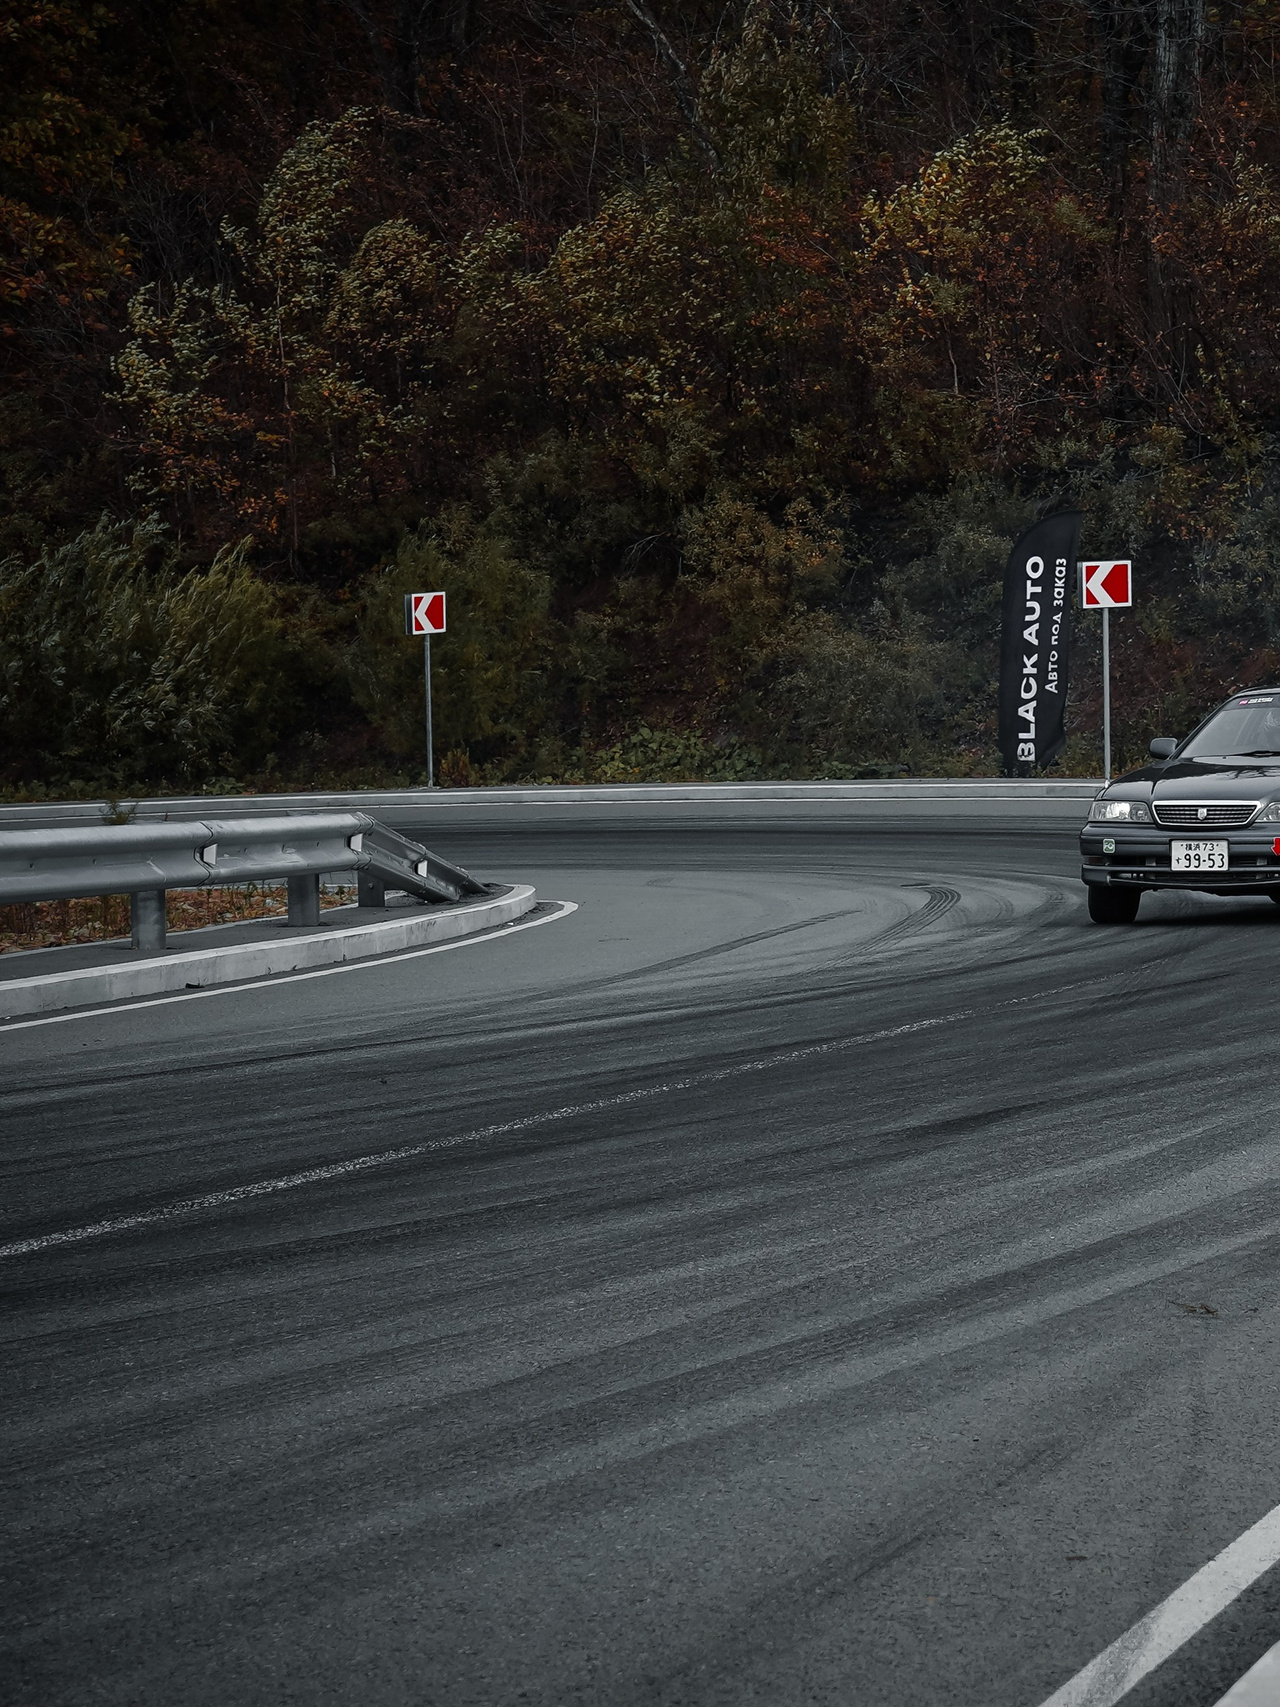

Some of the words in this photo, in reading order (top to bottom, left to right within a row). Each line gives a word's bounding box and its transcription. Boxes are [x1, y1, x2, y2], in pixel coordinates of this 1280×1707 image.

[1023, 555, 1045, 646] AUTO
[1053, 557, 1067, 607] заказ
[1051, 612, 1062, 645] под
[1017, 653, 1039, 762] BLACK
[1184, 853, 1225, 869] 99-53
